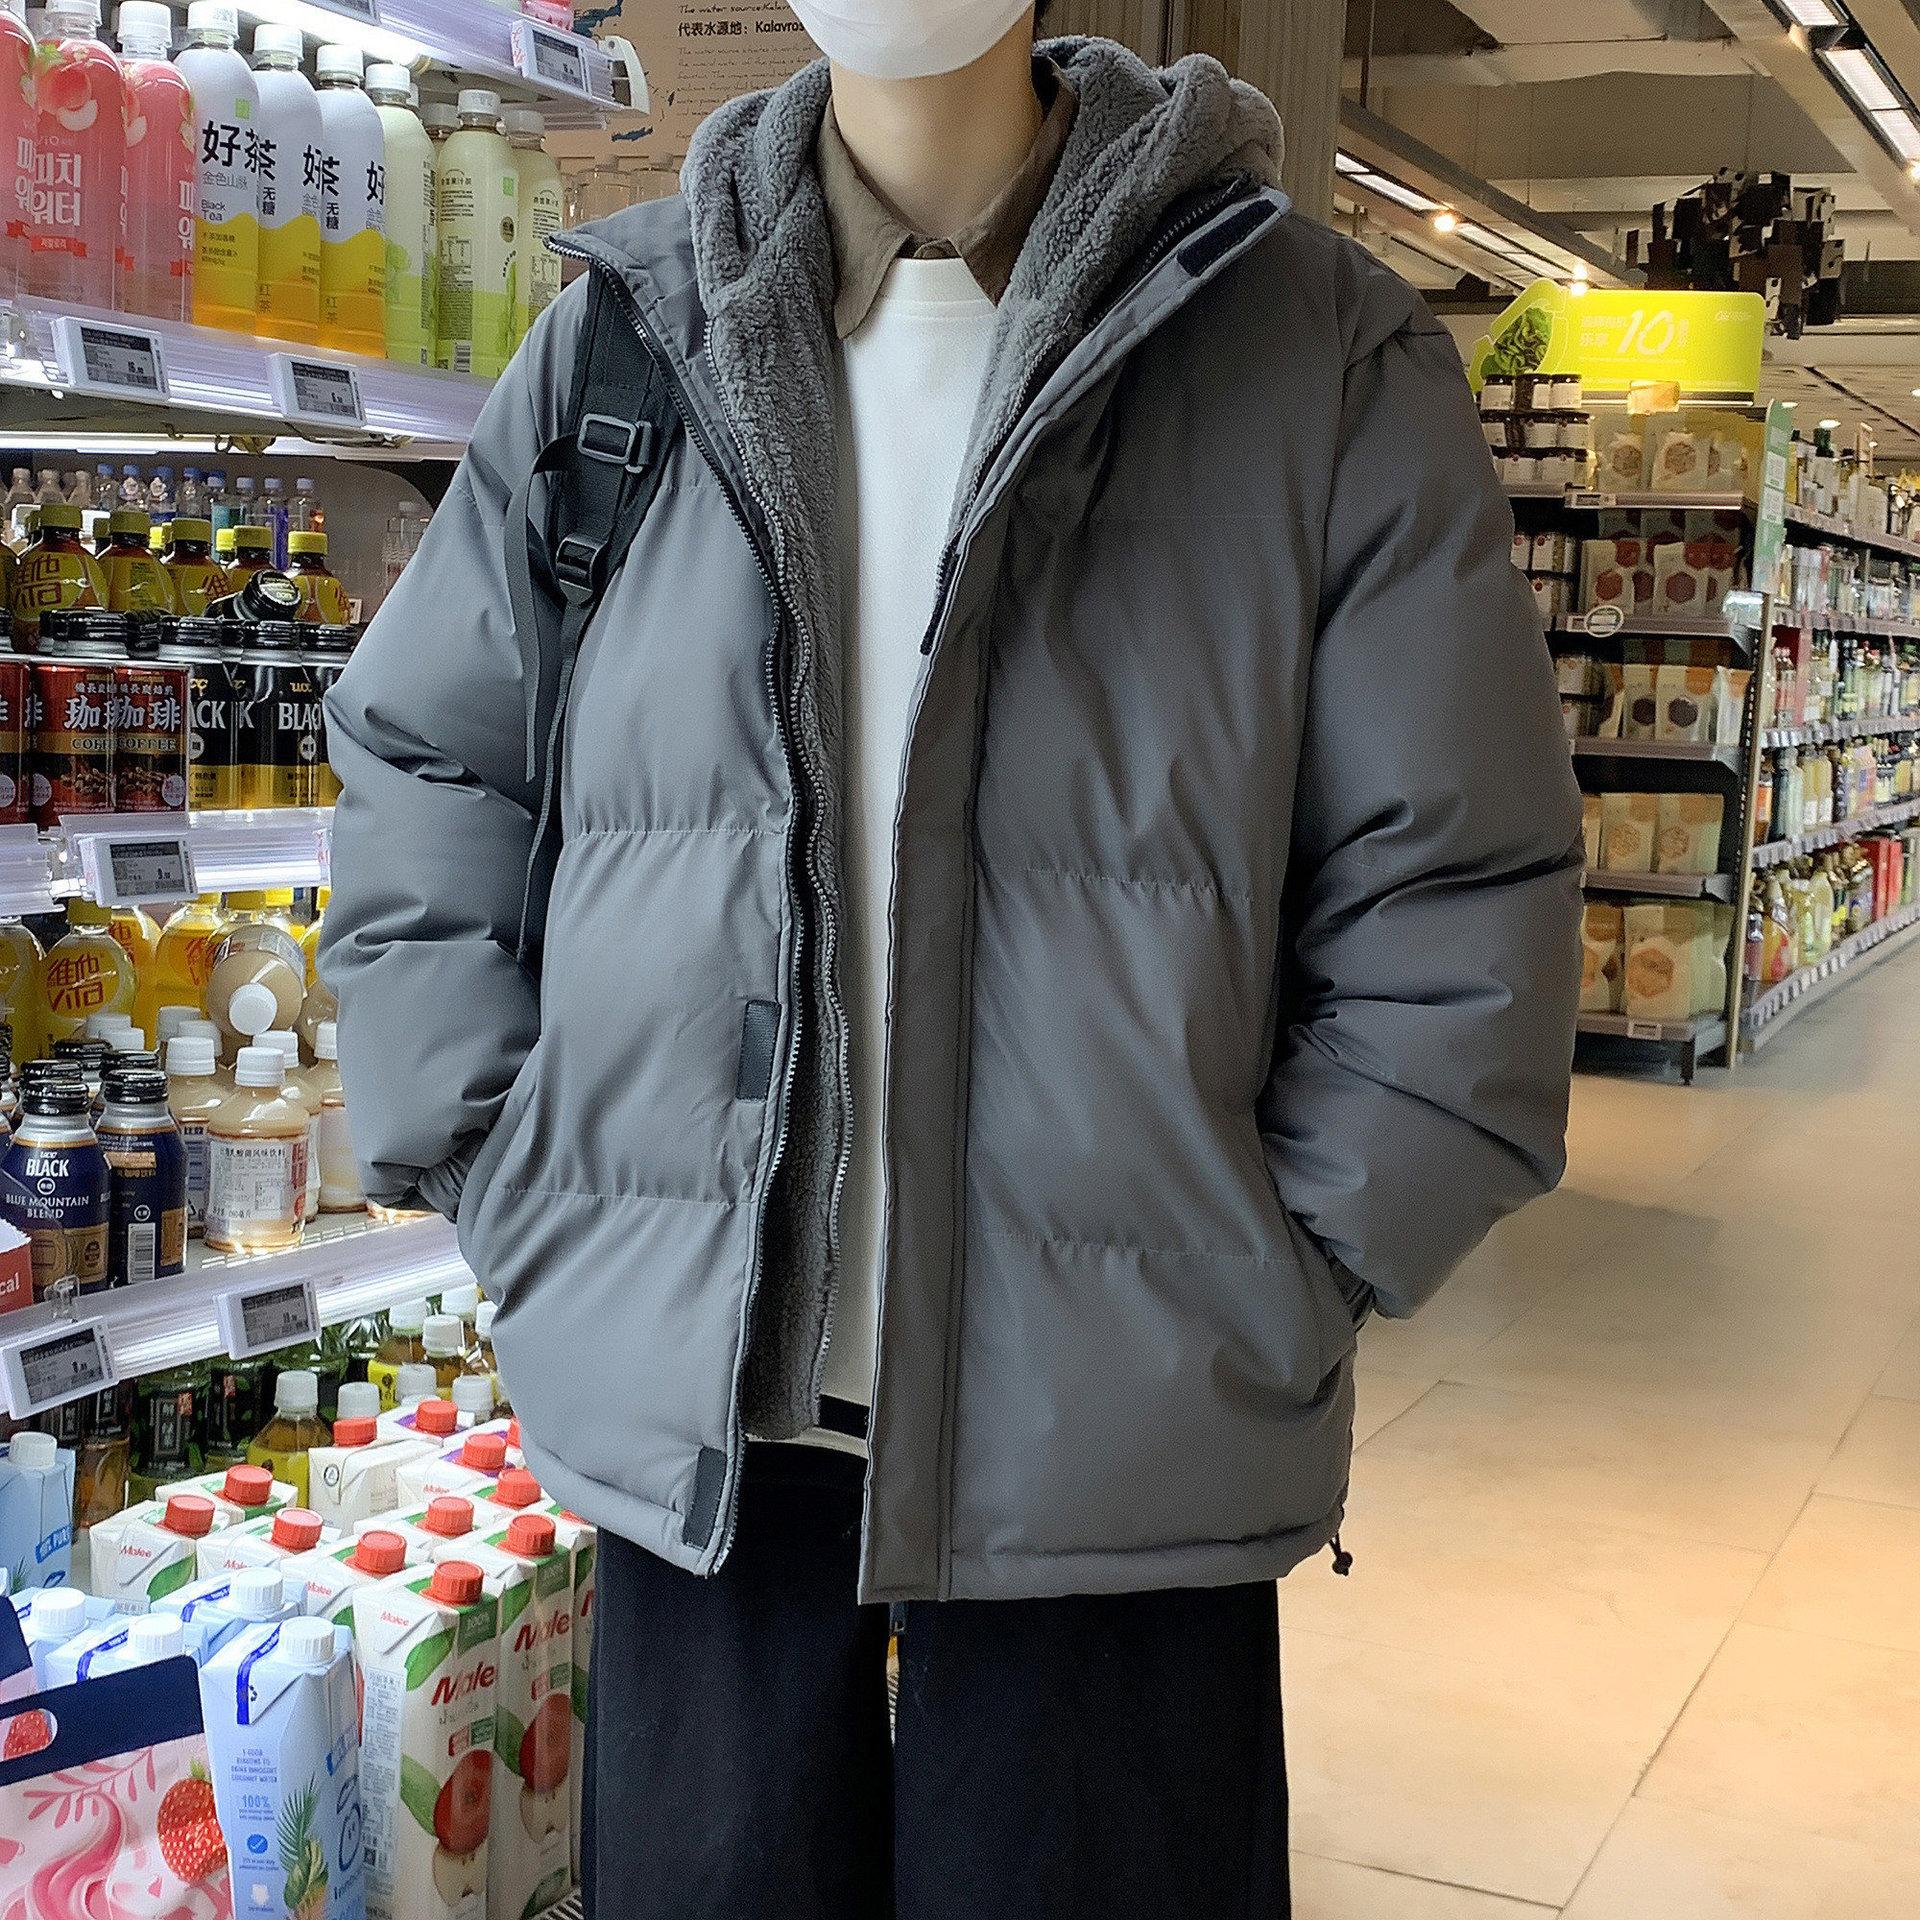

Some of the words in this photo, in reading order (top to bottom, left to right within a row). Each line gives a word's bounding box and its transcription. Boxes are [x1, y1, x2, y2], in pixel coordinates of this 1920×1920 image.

[679, 4, 696, 14] The
[700, 4, 727, 13] water
[36, 152, 82, 188] 피치
[32, 190, 81, 227] 워터
[1617, 310, 1675, 355] 10
[26, 1159, 69, 1177] BLACK
[5, 1193, 27, 1206] BLUE
[29, 1195, 90, 1207] MOUNTAIN
[27, 1208, 64, 1219] BLEND
[242, 1794, 270, 1808] 100%
